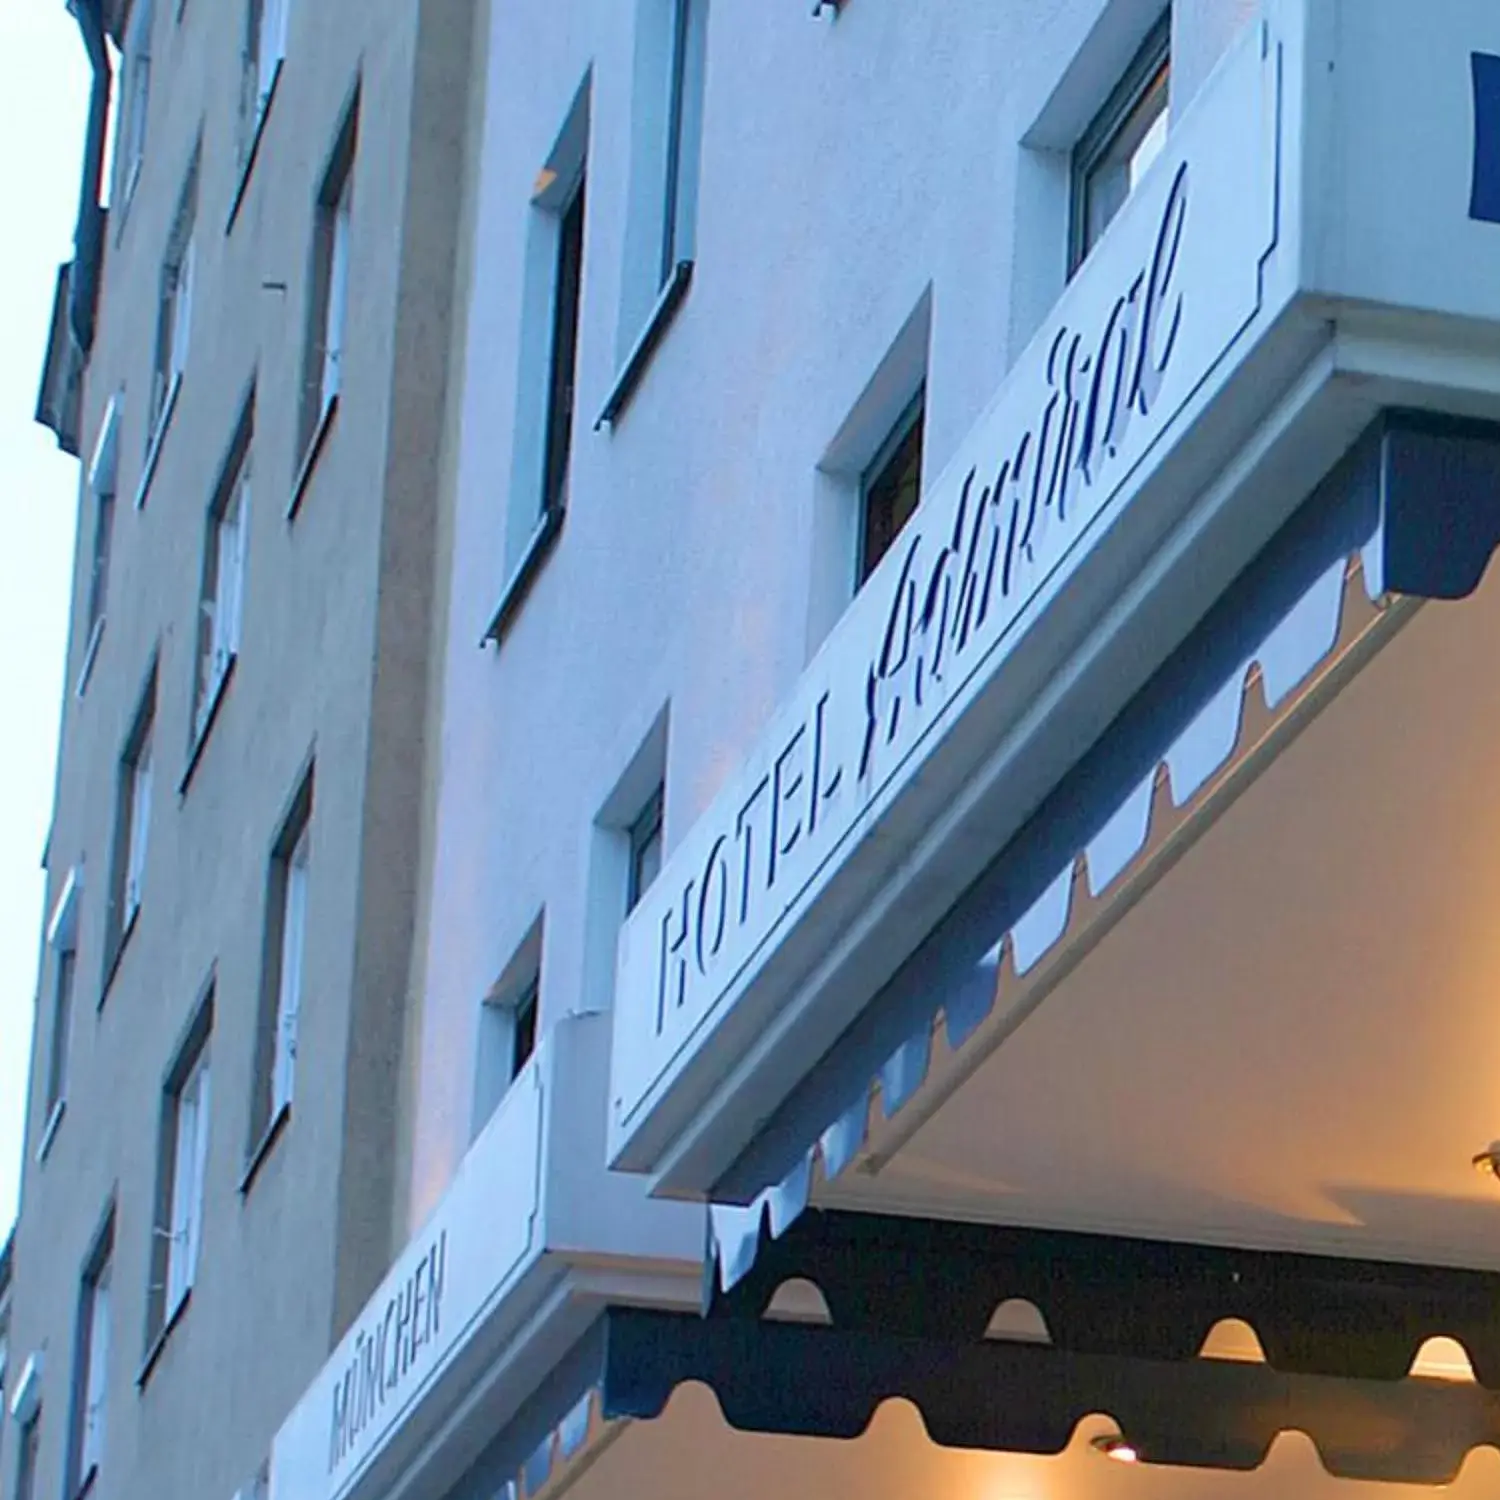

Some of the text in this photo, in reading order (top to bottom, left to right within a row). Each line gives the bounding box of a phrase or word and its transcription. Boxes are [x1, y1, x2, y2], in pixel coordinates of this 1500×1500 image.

[657, 160, 1188, 1034] HOTEL Admiral
[328, 1228, 446, 1475] MÜNCHEN
